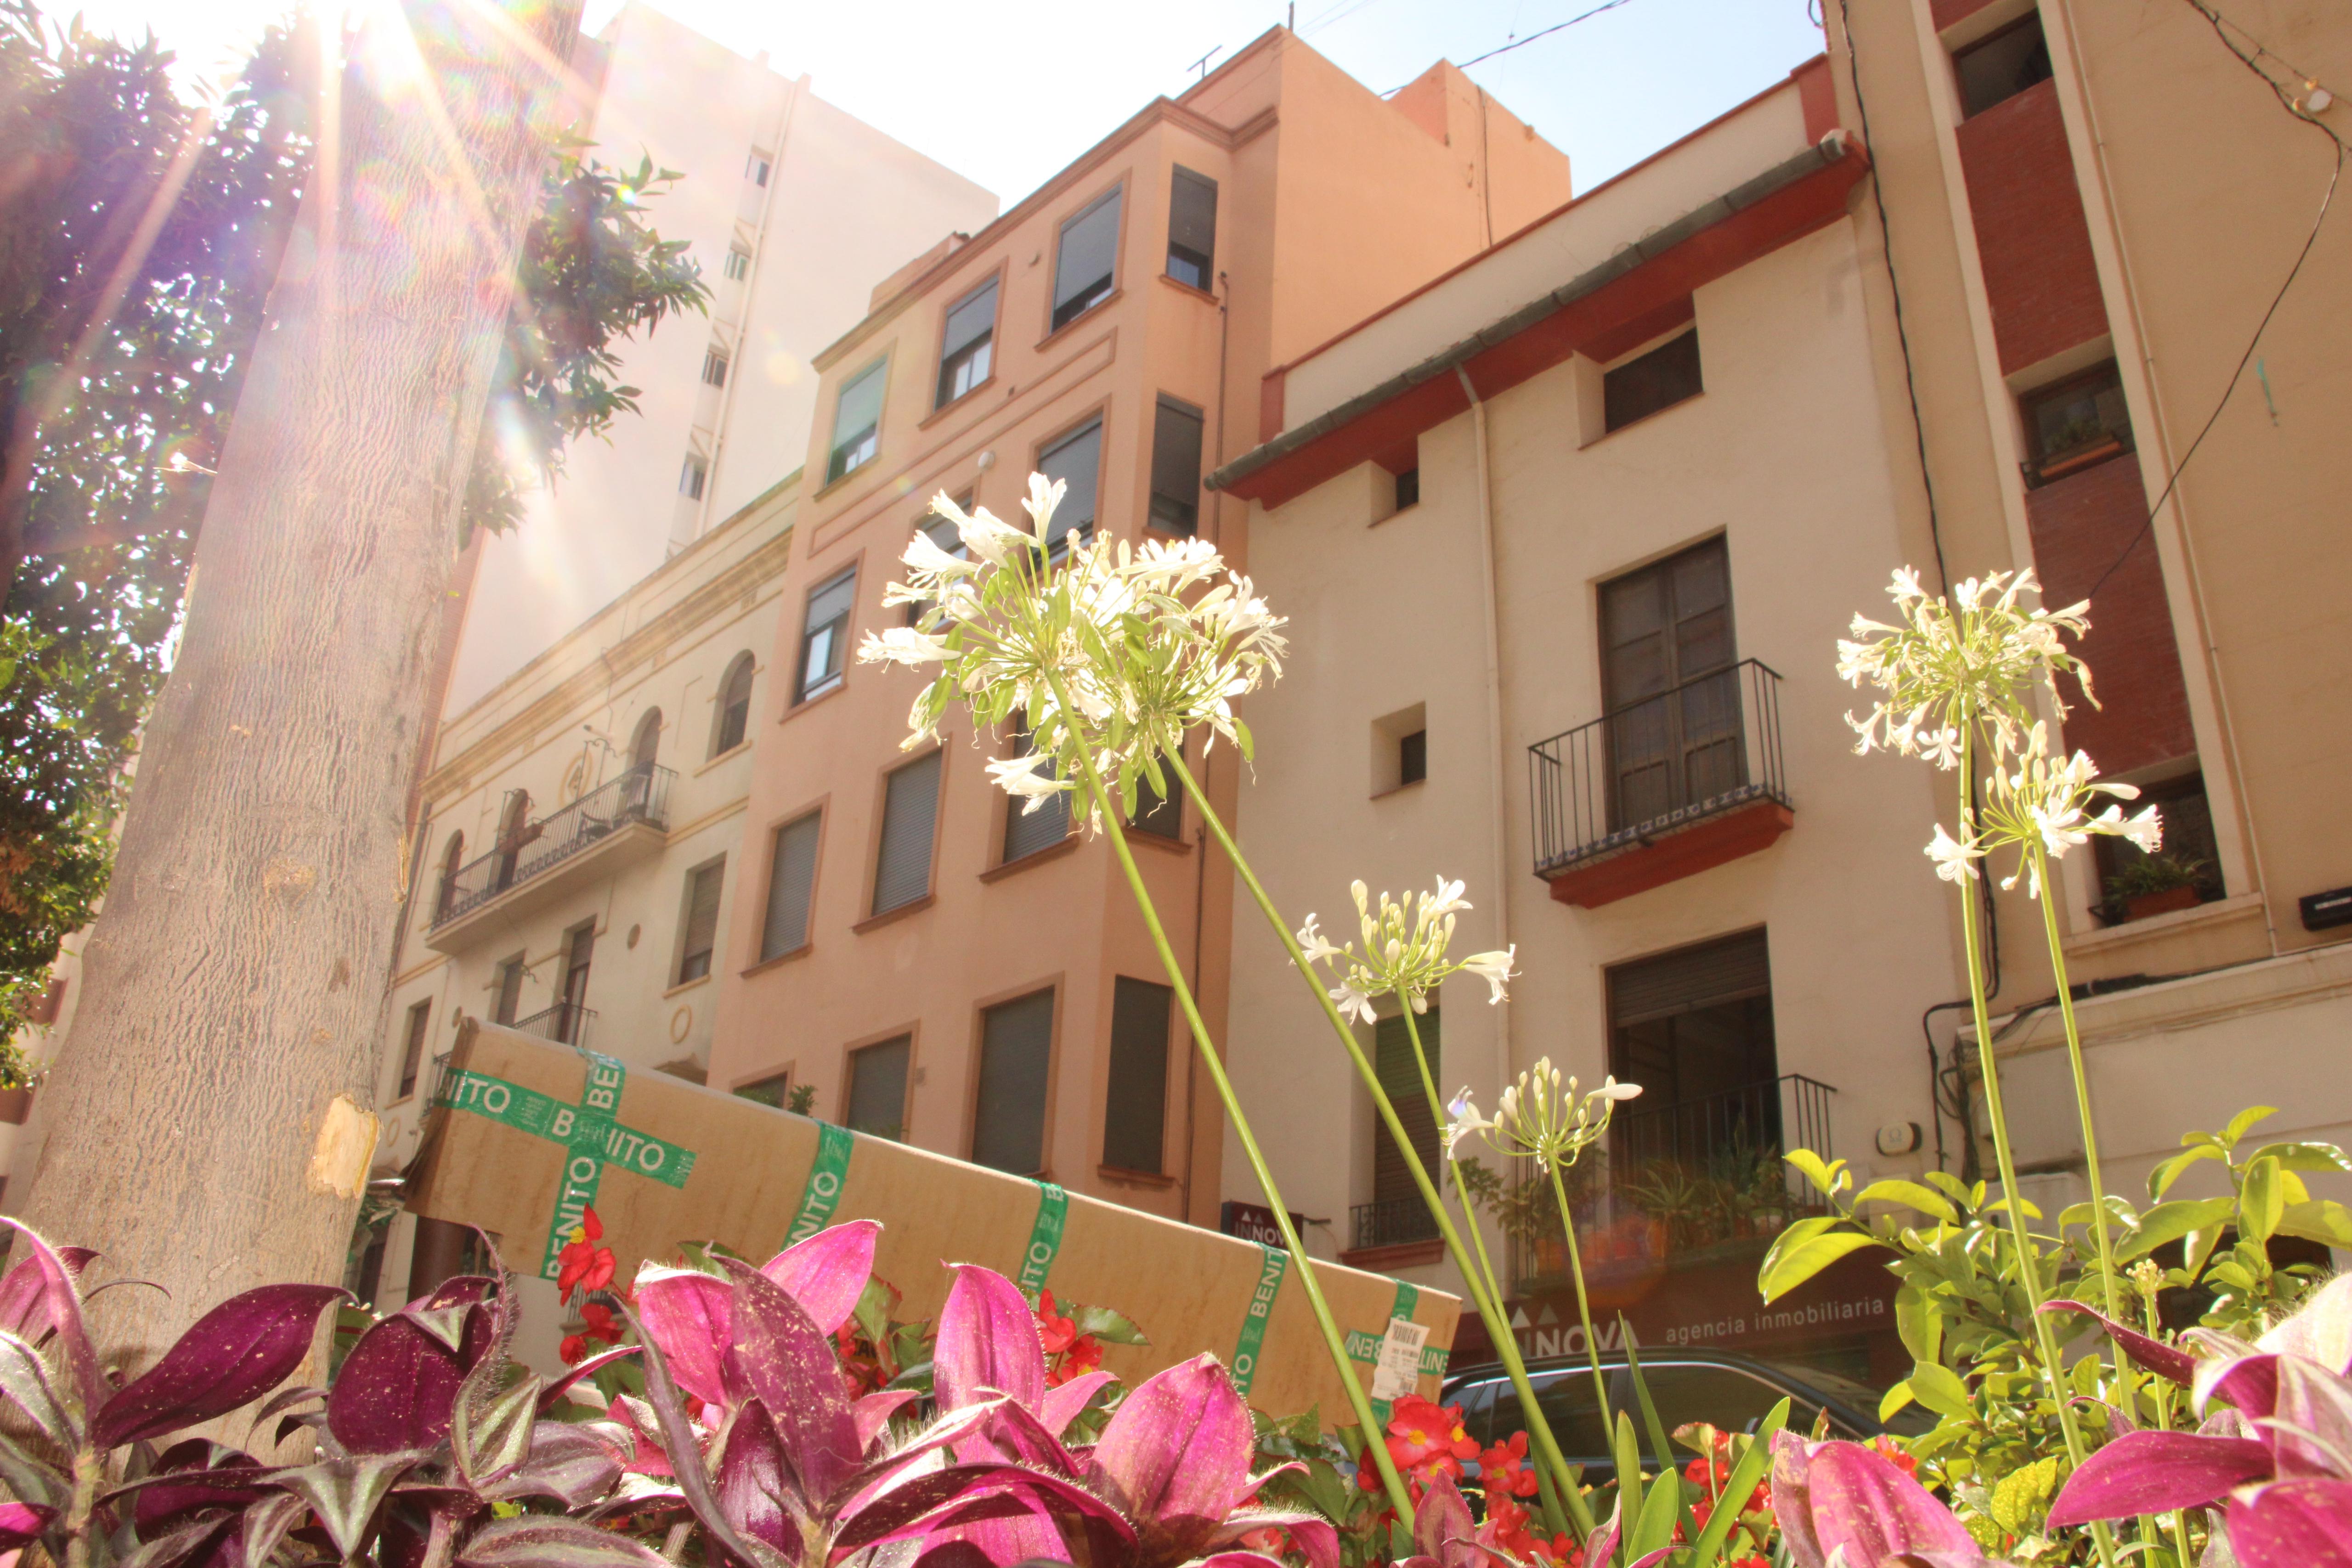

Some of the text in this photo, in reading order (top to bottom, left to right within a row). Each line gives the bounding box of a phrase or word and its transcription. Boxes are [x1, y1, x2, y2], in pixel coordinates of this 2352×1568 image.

[552, 1108, 665, 1171] BITO
[785, 1172, 838, 1251] NITO
[1235, 1221, 1287, 1246] INNOV
[1020, 1241, 1052, 1292] ITO
[1666, 1317, 1745, 1345] agencia
[1755, 1297, 1885, 1331] inmobiliaria
